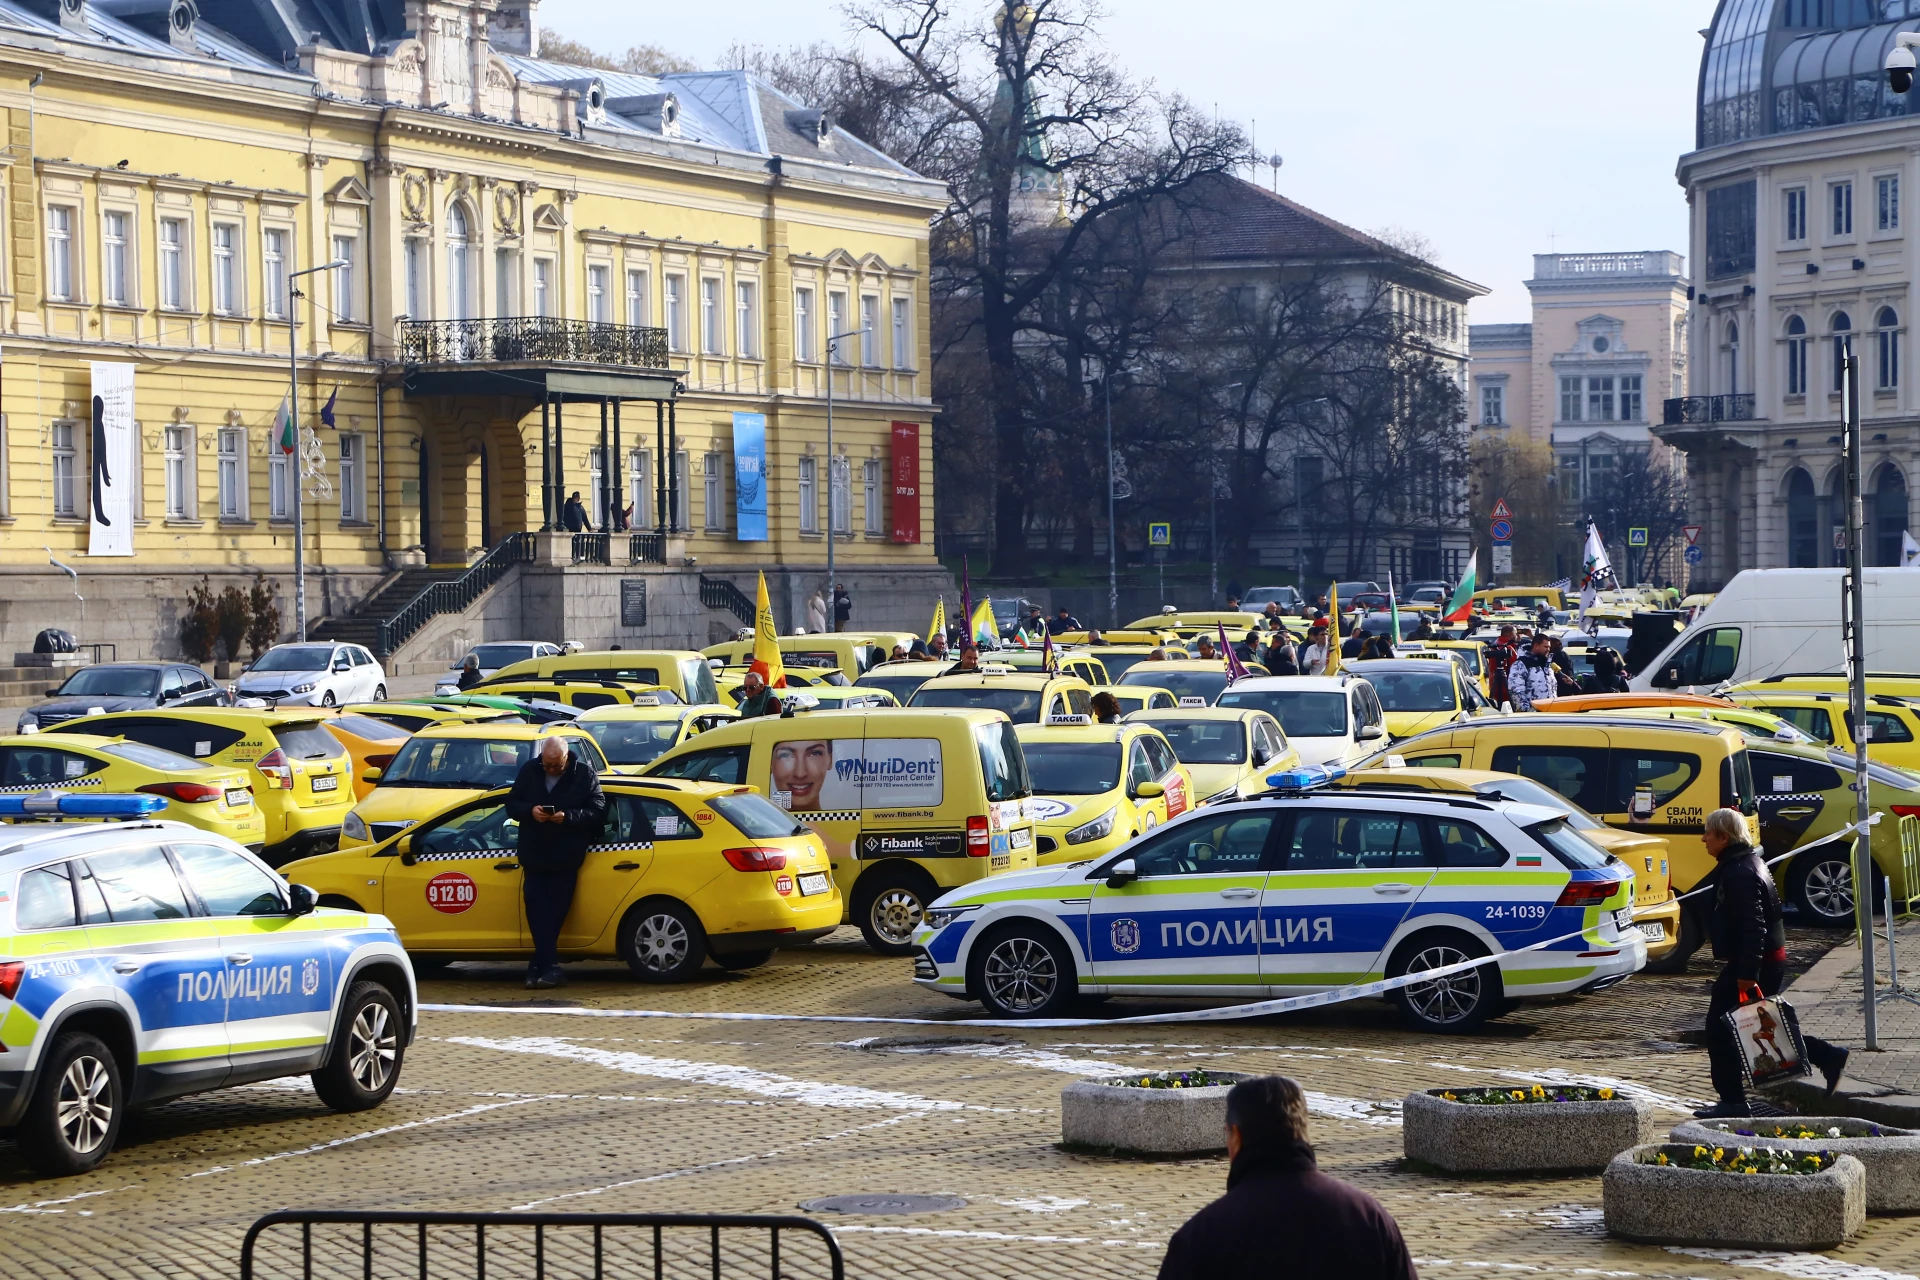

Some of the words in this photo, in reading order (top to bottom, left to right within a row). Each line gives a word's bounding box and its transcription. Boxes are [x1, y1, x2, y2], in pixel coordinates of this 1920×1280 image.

[853, 758, 936, 775] NuriDent
[853, 774, 878, 782] Dental
[880, 774, 908, 783] Implant
[910, 773, 935, 781] Center
[874, 811, 934, 819] www.fibank.bg
[1666, 807, 1703, 815] СВАЛИ
[1666, 816, 1703, 825] TaxiMe
[881, 837, 924, 849] Fibank
[1485, 905, 1546, 919] 24-1039
[1160, 916, 1334, 948] ПОЛИЦИЯ
[28, 958, 80, 979] 24-1070
[177, 964, 293, 1003] ПОЛИЦИЯ
